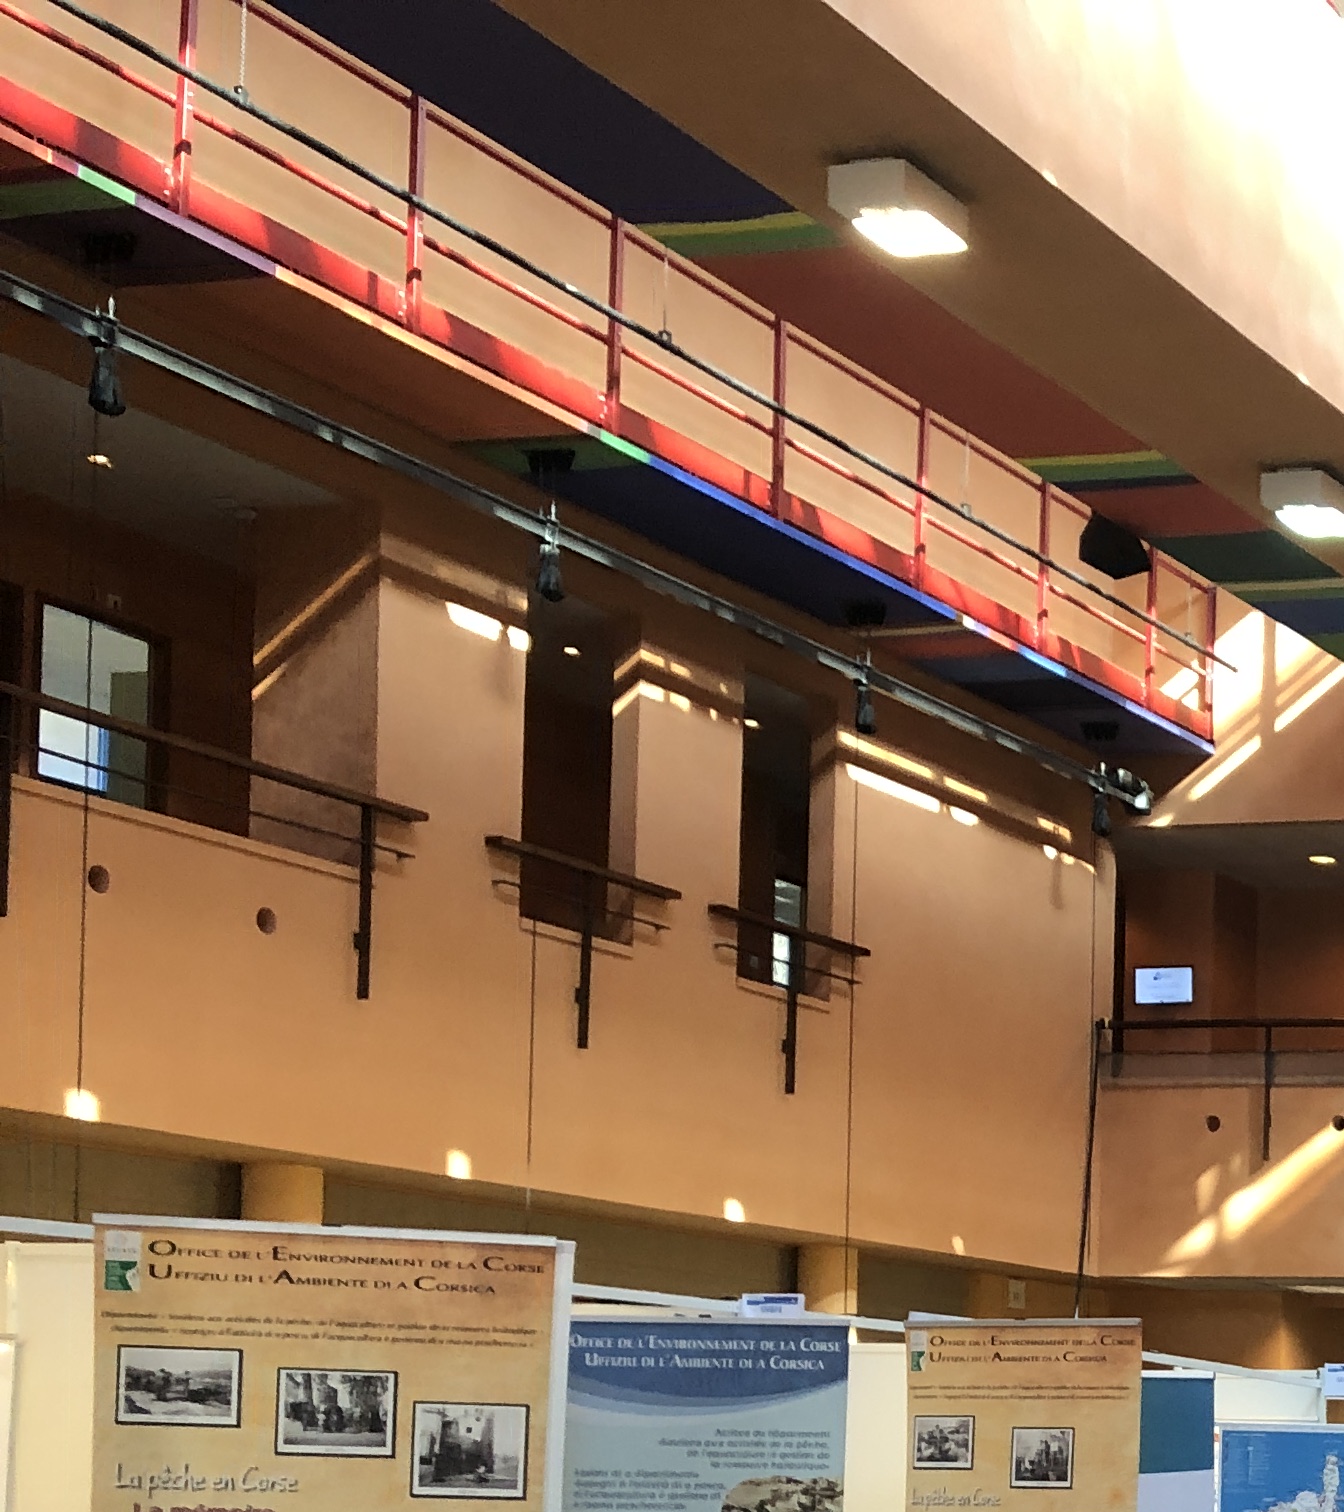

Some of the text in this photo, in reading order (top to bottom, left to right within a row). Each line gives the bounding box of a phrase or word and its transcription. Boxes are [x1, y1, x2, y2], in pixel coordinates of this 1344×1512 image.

[148, 1239, 220, 1258] OFFICE
[457, 1261, 477, 1271] LA
[483, 1255, 545, 1274] CORSE
[414, 1275, 496, 1295] CORSICA
[800, 1337, 841, 1353] CORSE
[770, 1355, 825, 1371] CORSICA
[114, 1463, 142, 1490] La
[213, 1476, 236, 1492] en
[242, 1466, 299, 1493] Corse
